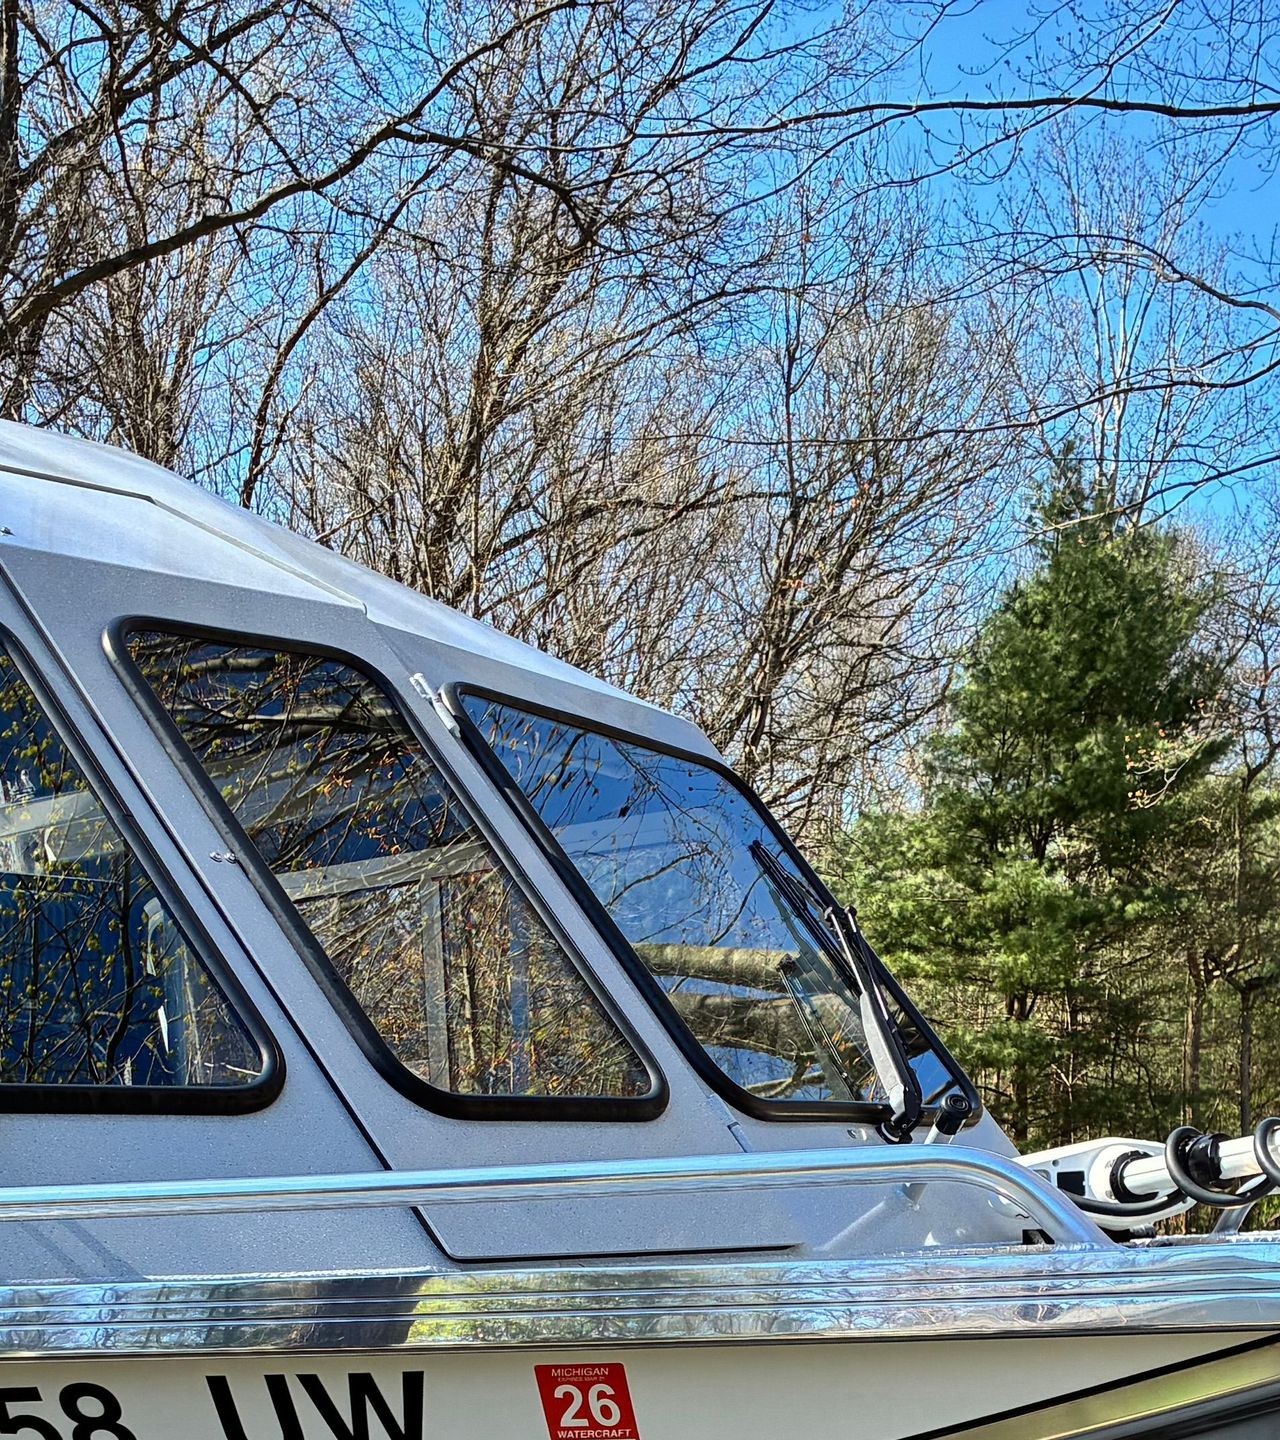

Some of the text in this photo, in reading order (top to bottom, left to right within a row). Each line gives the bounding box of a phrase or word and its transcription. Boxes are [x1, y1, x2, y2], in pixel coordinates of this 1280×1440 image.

[551, 1367, 609, 1377] MICHIGAN
[554, 1383, 621, 1428] 26
[557, 1429, 631, 1439] WATERCRAFT
